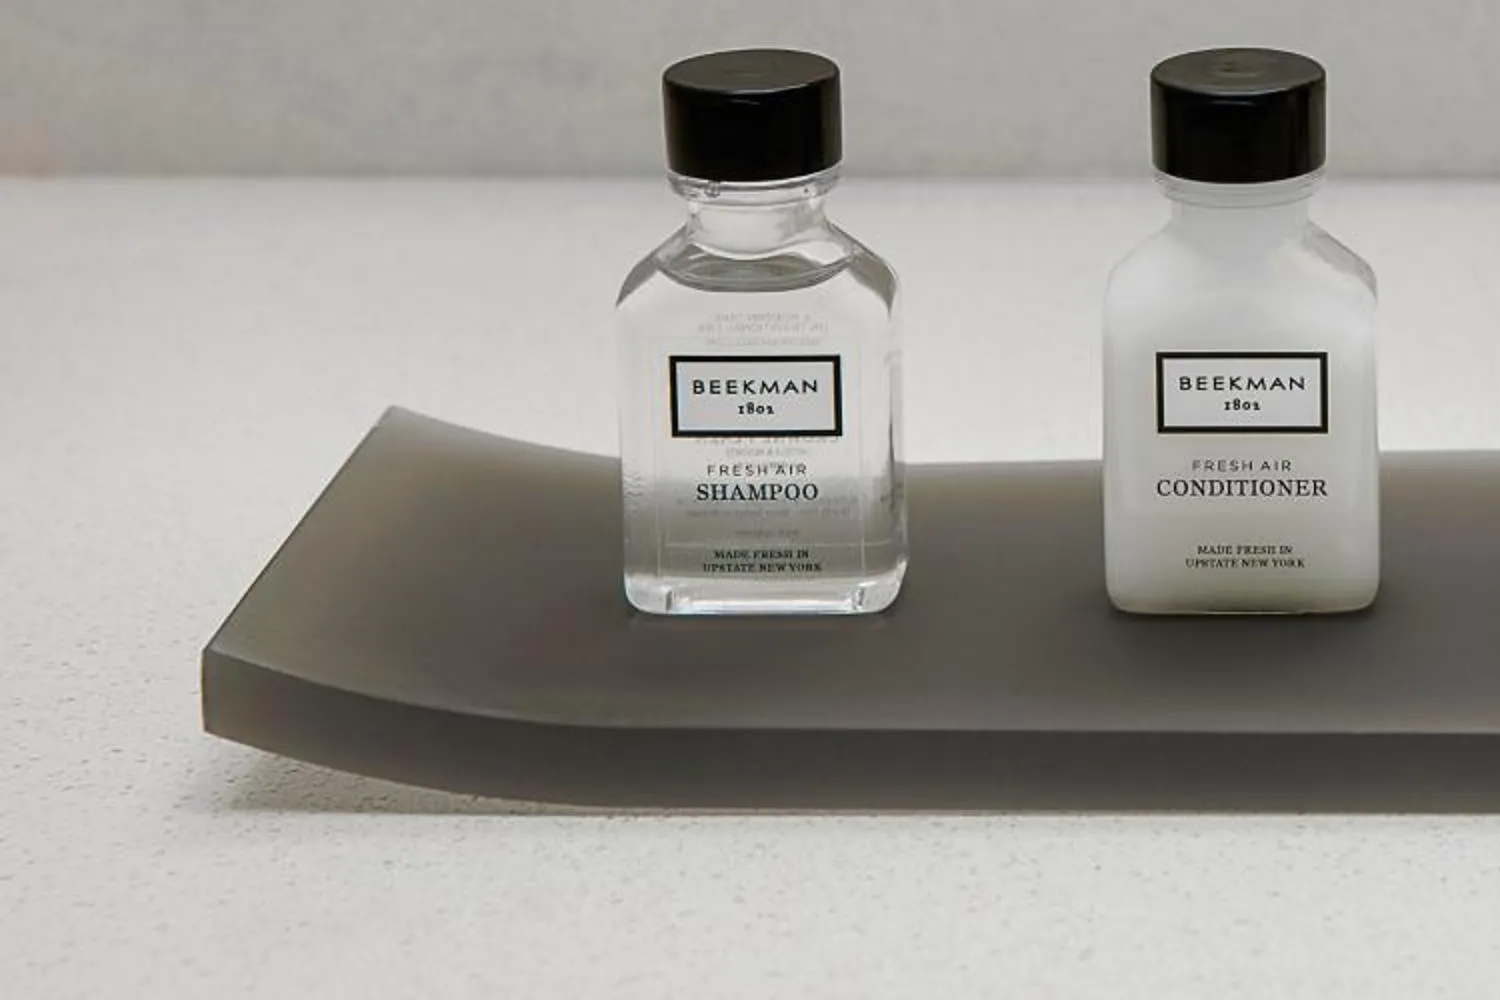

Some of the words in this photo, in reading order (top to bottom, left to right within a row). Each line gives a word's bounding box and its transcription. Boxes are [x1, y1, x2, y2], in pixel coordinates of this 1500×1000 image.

[692, 379, 819, 395] BEEKMAN
[1179, 375, 1306, 391] BEEKMAN
[737, 401, 775, 415] 1802
[707, 464, 769, 477] FRESH
[775, 464, 808, 476] AIR
[1192, 459, 1253, 472] FRESH
[1260, 459, 1292, 472] AIR
[696, 483, 819, 501] SHAMPOO
[1157, 479, 1328, 497] CONDITIONER
[714, 549, 751, 559] MADE
[754, 549, 793, 559] FRESH
[796, 549, 809, 559] IN
[1197, 545, 1233, 555] MADE
[1237, 545, 1276, 555] FRESH
[1279, 545, 1293, 555] IN
[703, 563, 755, 574] UPSTATE
[759, 563, 786, 573] NEW
[787, 563, 823, 573] YORK
[1185, 558, 1237, 569] UPSTATE
[1241, 558, 1269, 568] NEW
[1271, 558, 1306, 568] YORK
